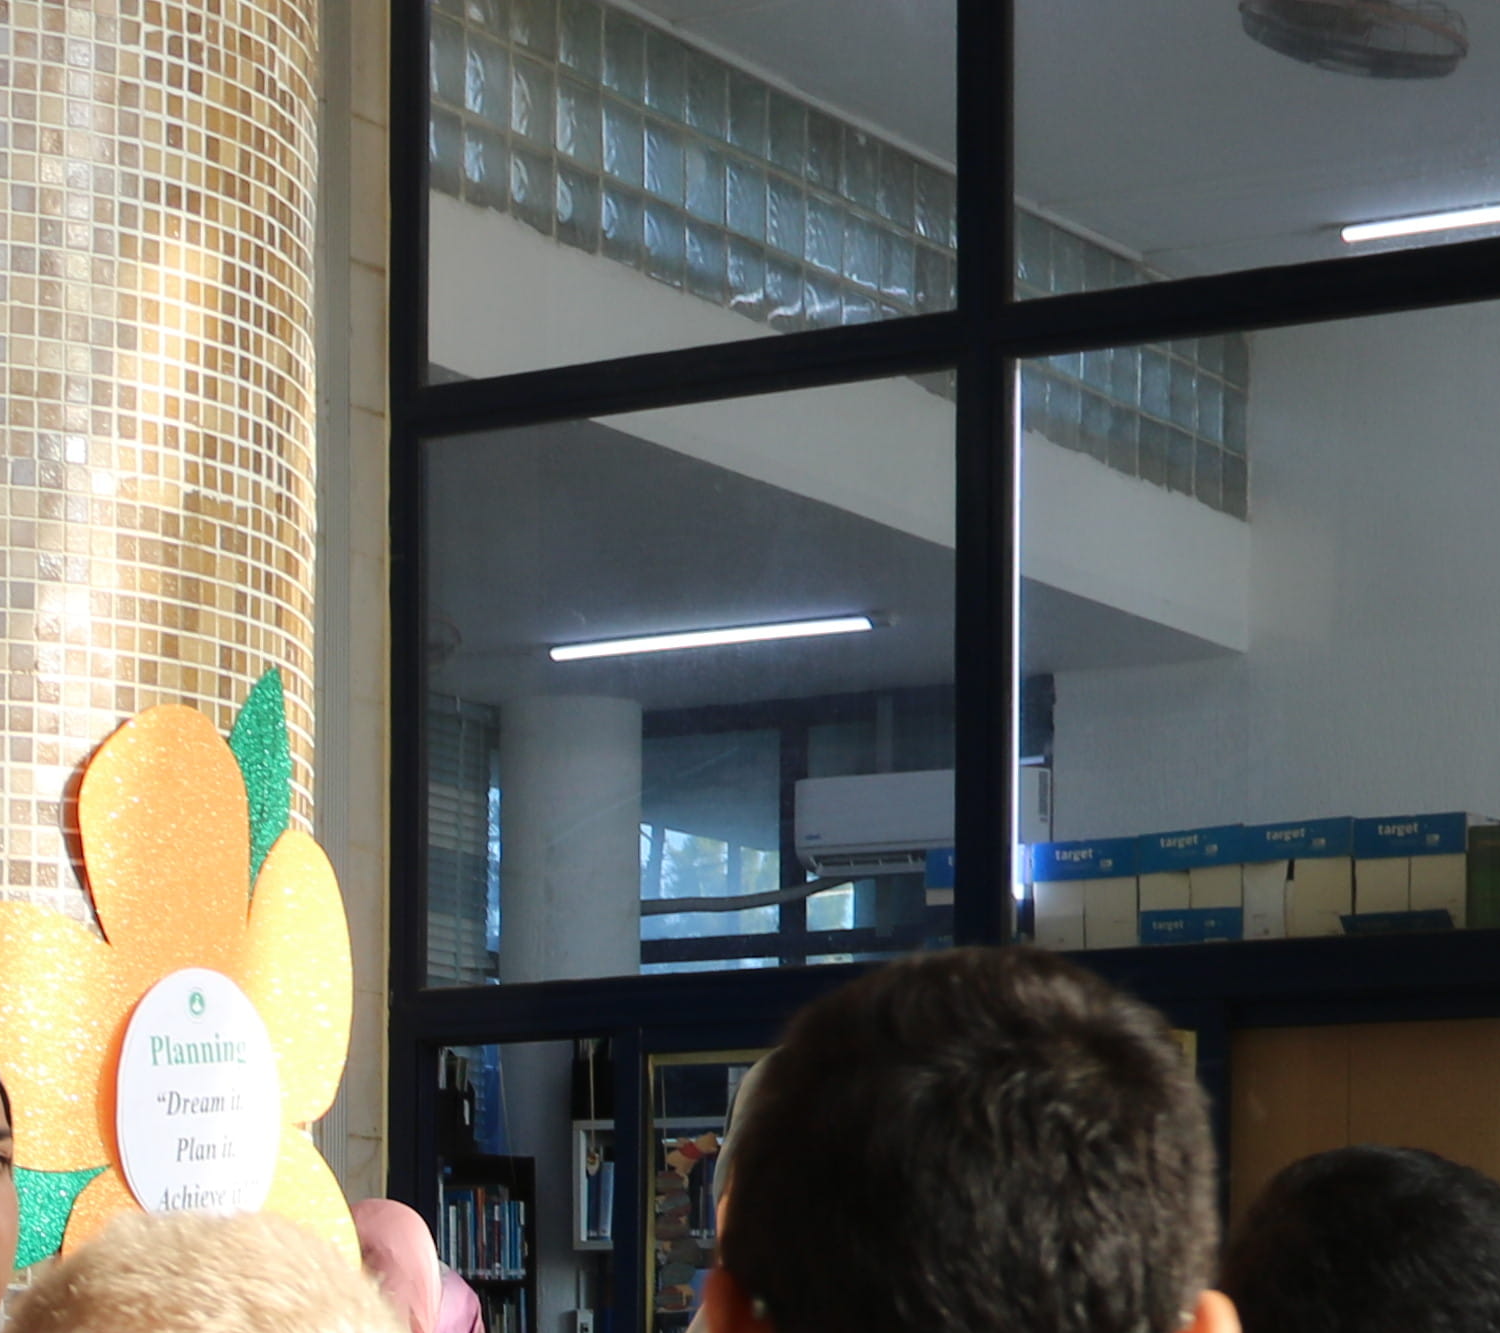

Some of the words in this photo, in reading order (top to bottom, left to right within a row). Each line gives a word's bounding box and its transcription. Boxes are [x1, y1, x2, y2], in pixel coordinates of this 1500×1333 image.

[1266, 828, 1305, 843] target
[1377, 821, 1419, 837] target
[1159, 834, 1199, 849] target
[1055, 847, 1094, 862] target
[149, 1032, 247, 1067] Planning
[175, 1136, 217, 1163] Plan
[159, 1184, 227, 1212] Achieve
